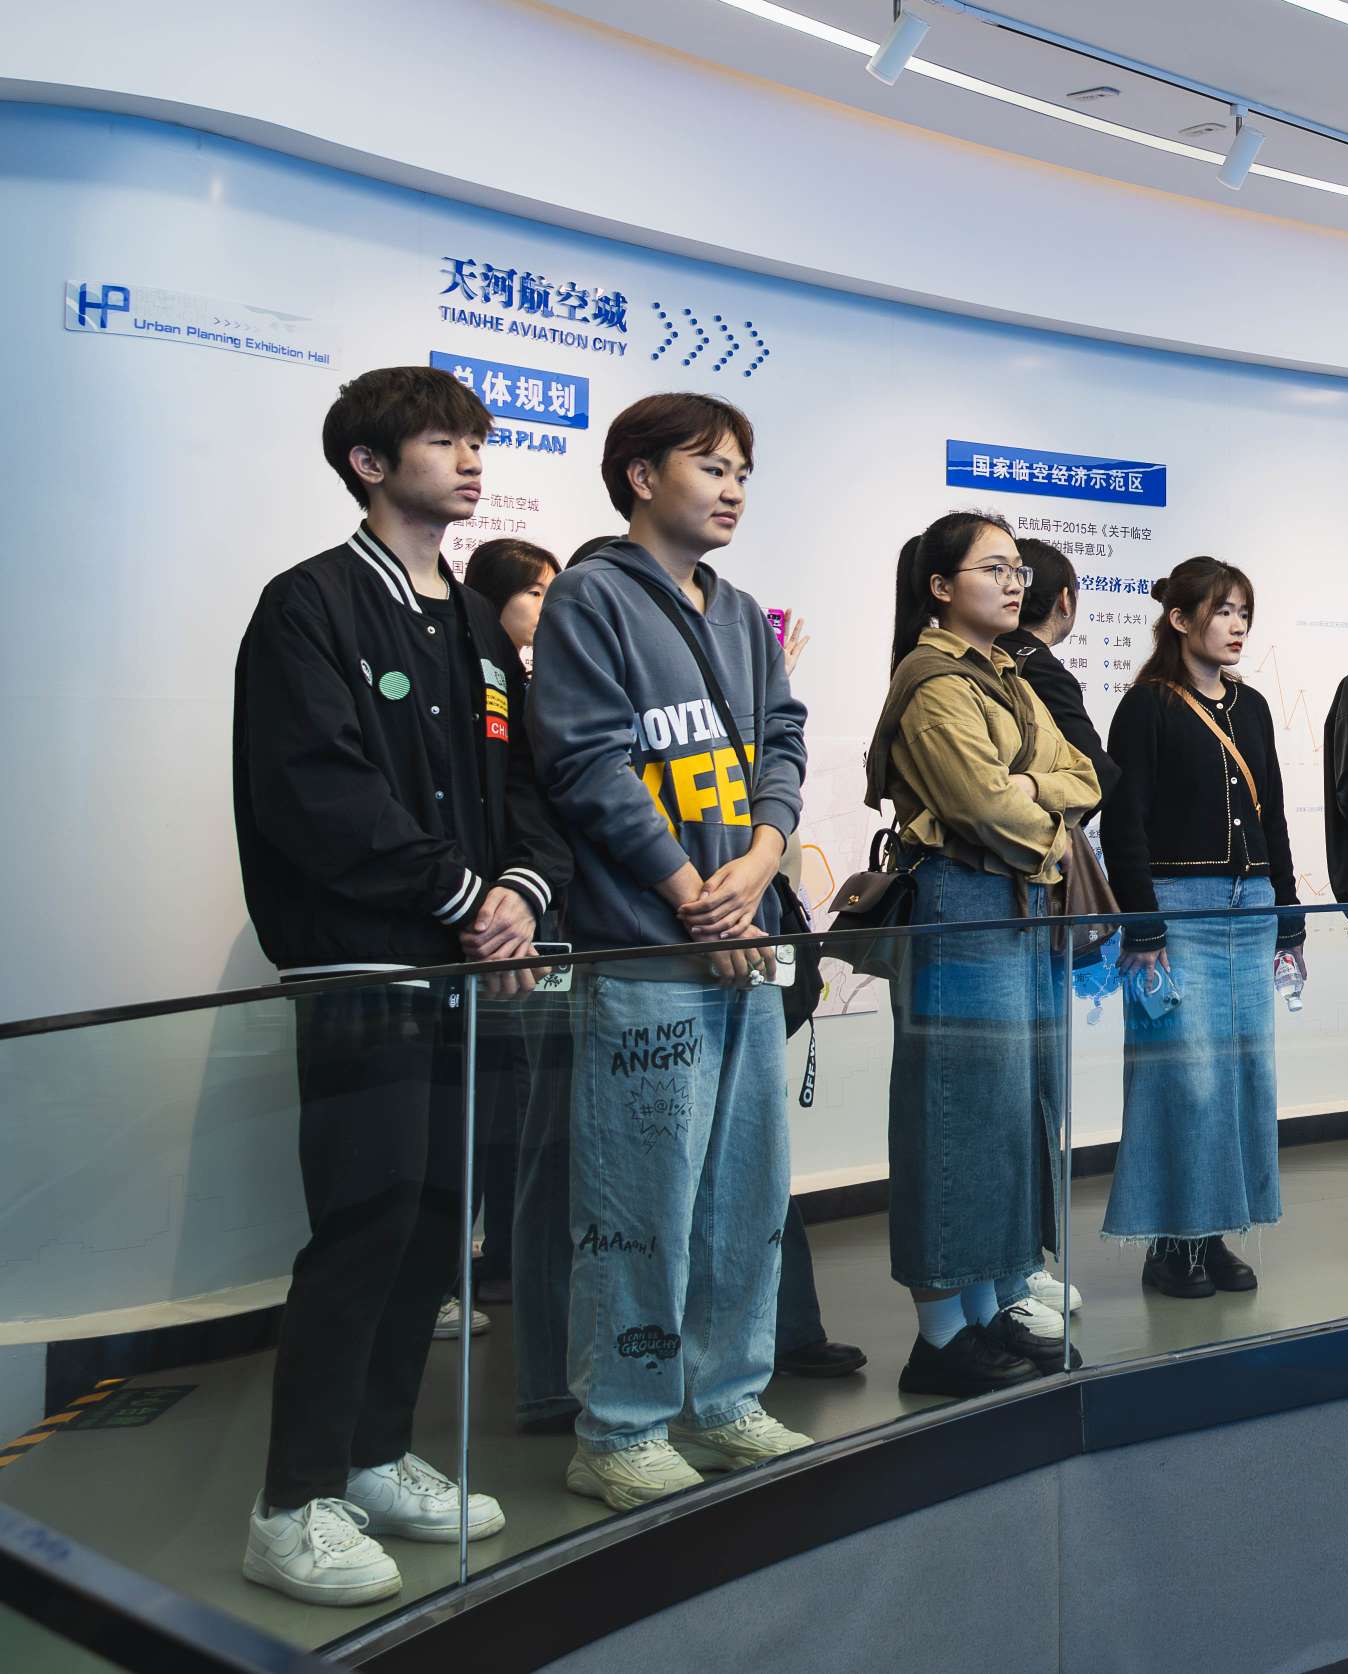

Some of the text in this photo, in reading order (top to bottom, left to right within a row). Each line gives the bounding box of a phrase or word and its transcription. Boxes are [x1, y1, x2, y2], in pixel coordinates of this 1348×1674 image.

[440, 256, 628, 333] 天河航空城
[134, 318, 330, 365] Urban Planning Exhibition Hall
[439, 305, 628, 357] TIANHE AVIATION CITY
[516, 429, 566, 454] PLAN
[972, 454, 1144, 493] 国家临空经济示范区
[1018, 516, 1152, 541] 民航局于2015年《关于临空
[453, 537, 485, 551] 多彩
[453, 560, 470, 574] 国
[1069, 633, 1132, 648] 广州 上海
[1069, 657, 1132, 671] 贵阳 杭州
[622, 1017, 696, 1050] I'M NOT
[611, 1032, 704, 1078] ANGRY!
